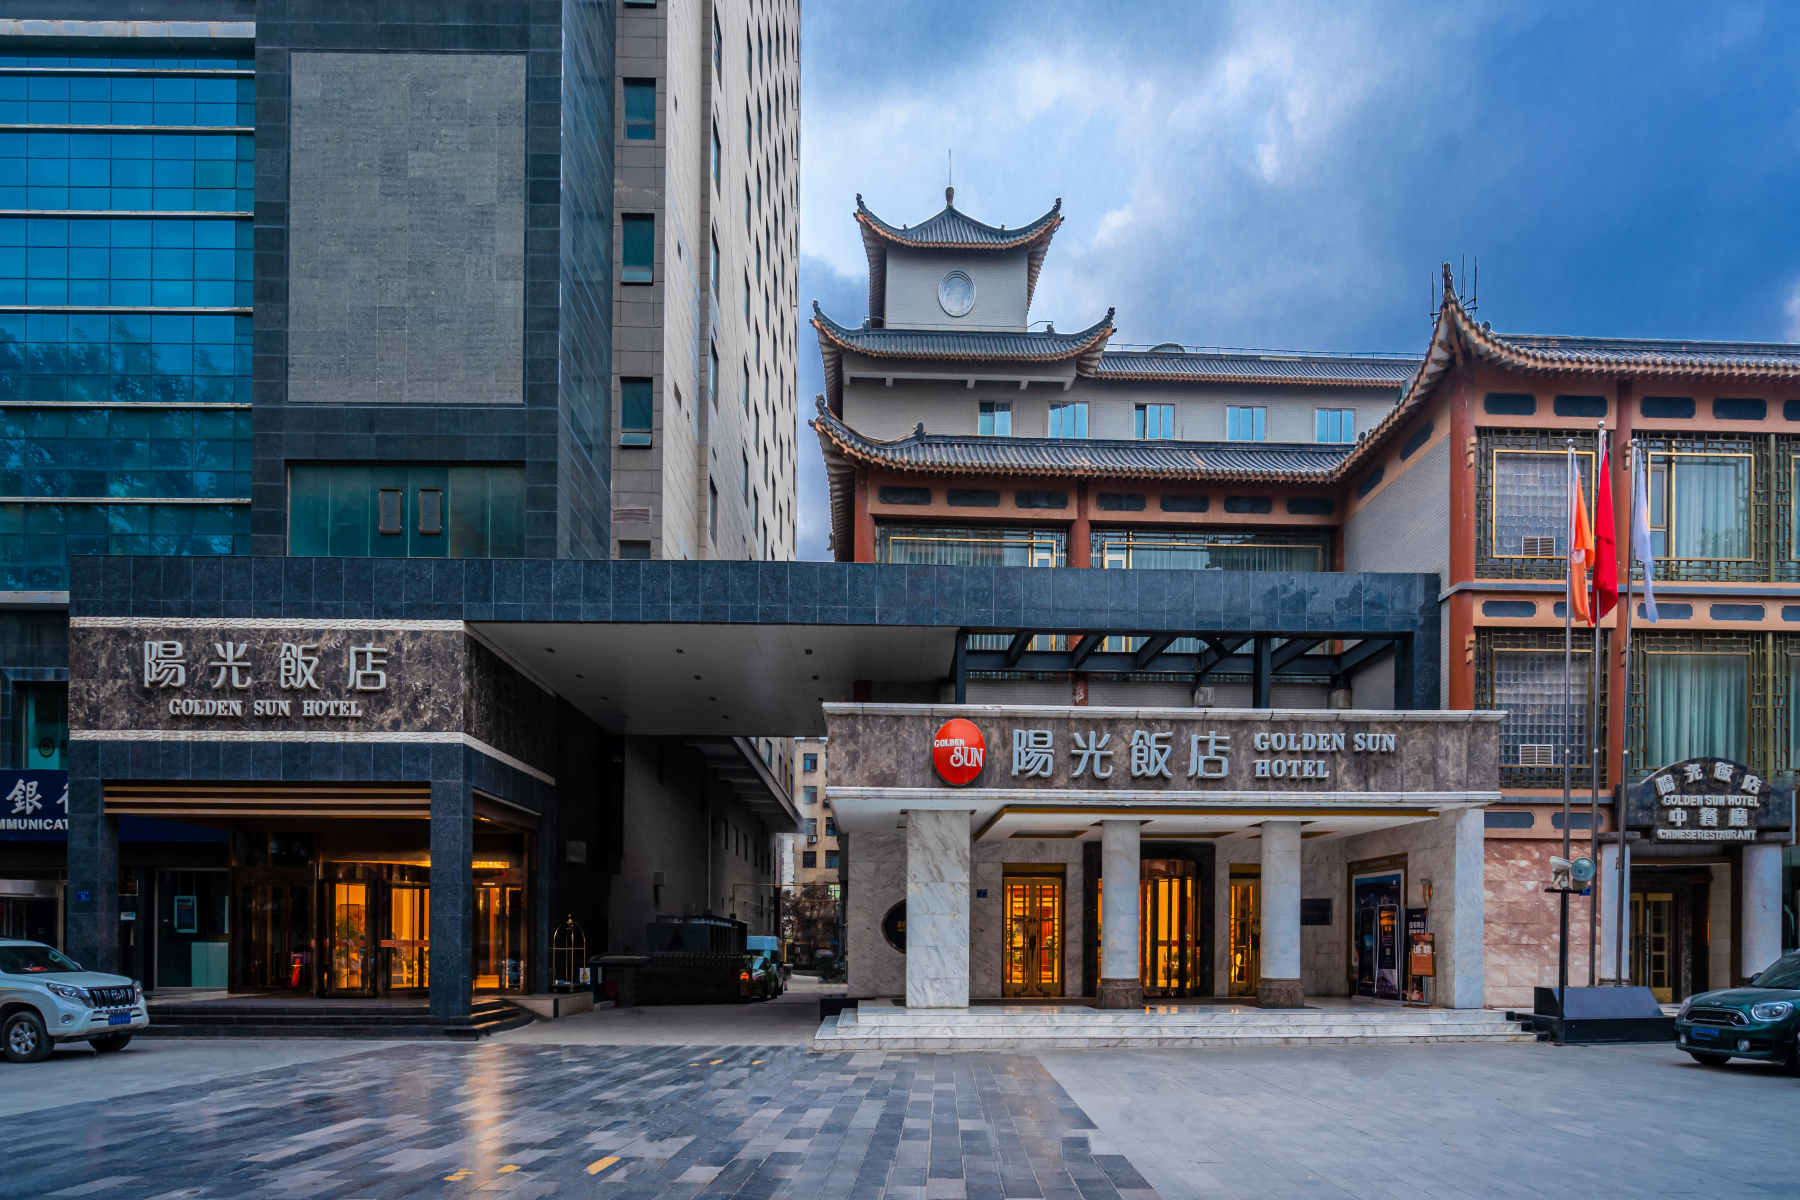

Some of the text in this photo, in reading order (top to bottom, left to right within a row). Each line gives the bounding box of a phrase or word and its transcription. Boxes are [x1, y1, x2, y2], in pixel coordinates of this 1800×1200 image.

[144, 641, 388, 691] 陽光飯店
[168, 698, 363, 718] GOLDEN SUN HOTEL
[934, 738, 965, 748] GOLDEN
[1253, 732, 1397, 752] GOLDEN SUN
[950, 746, 984, 768] SUN
[1011, 729, 1231, 779] 陽光飯店
[1253, 759, 1330, 779] HOTEL
[1655, 761, 1763, 796] 陽光飯店
[1661, 794, 1760, 808] GOLDEN SUN HOTEL
[1668, 807, 1749, 828] 中餐廳
